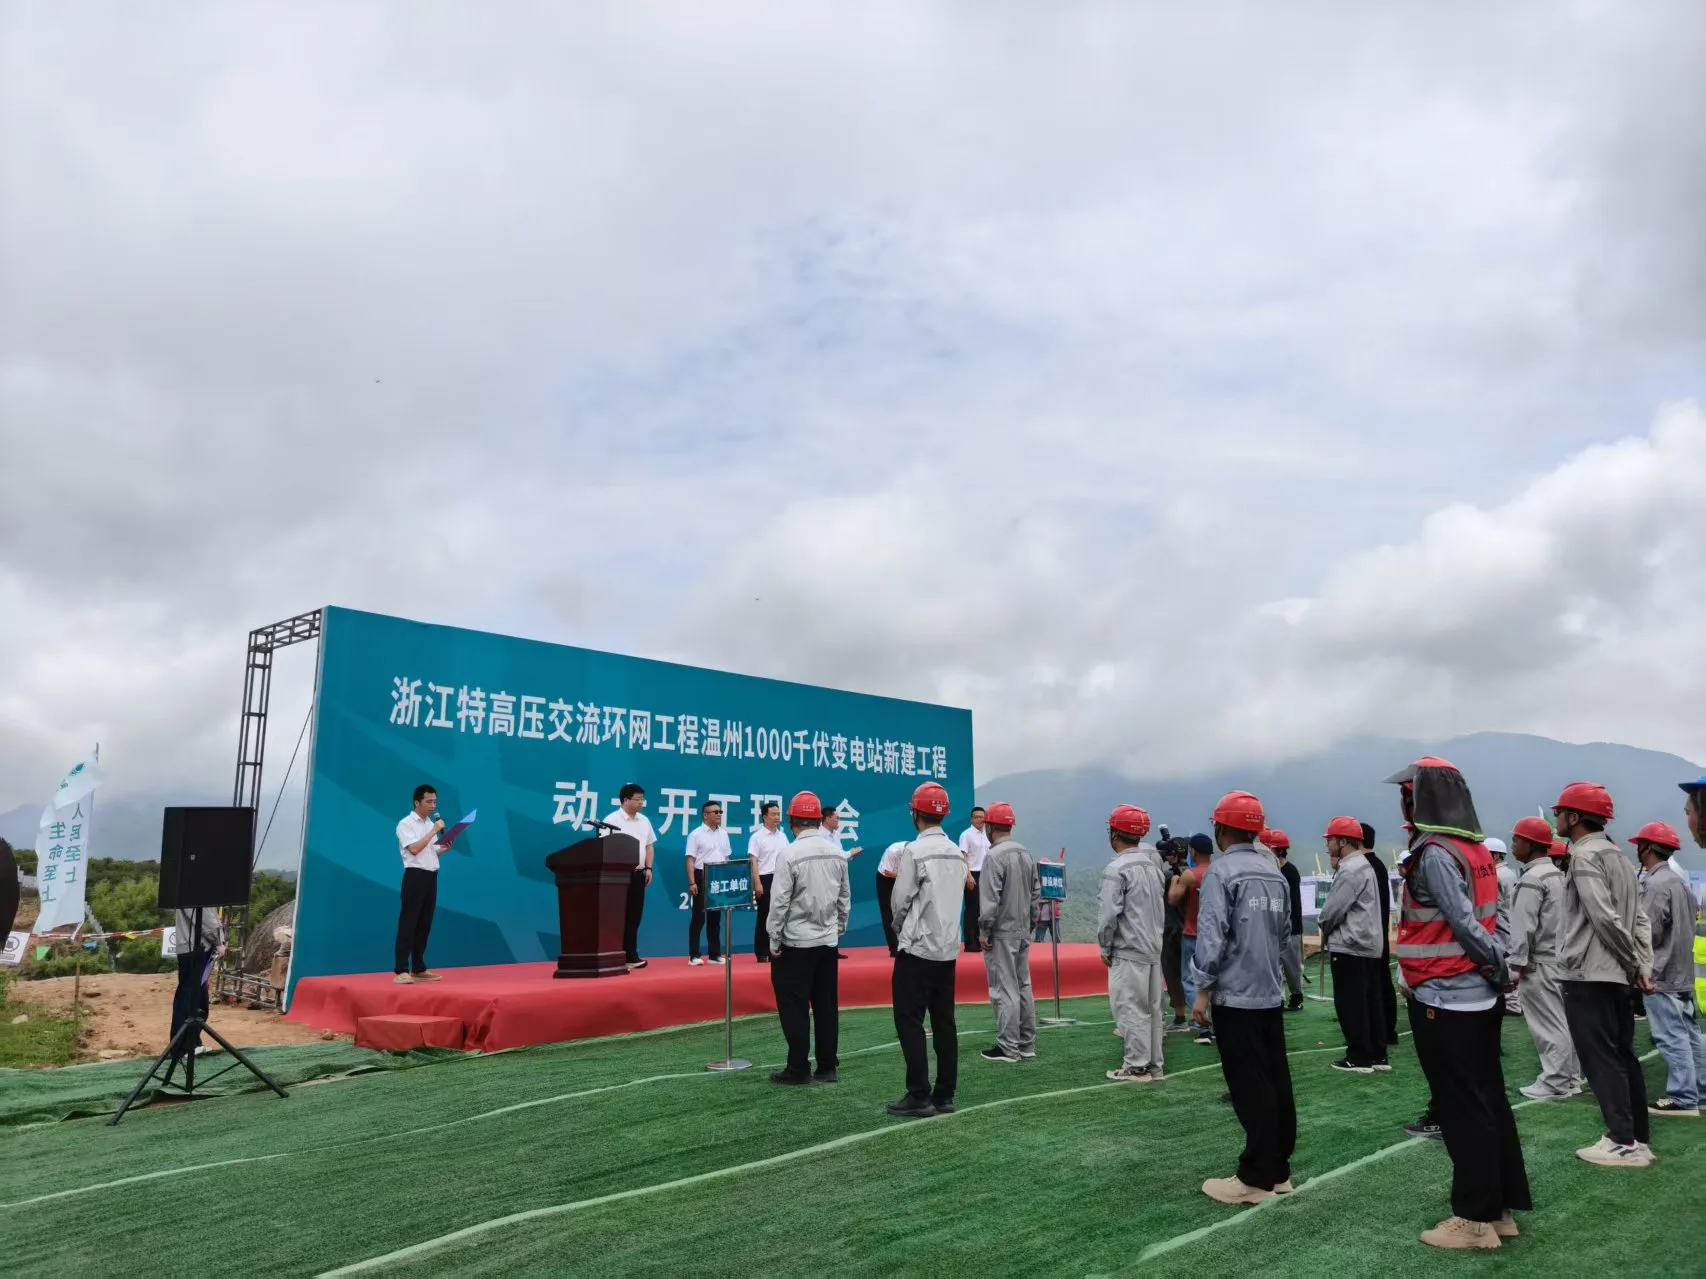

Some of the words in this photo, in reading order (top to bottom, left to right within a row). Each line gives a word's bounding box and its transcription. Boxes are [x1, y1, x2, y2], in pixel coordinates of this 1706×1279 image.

[389, 676, 947, 779] 浙江特高压交流环网工程温州1000千伏变电站新建工程
[552, 780, 860, 841] 动开工现会
[710, 878, 748, 894] 施工单位
